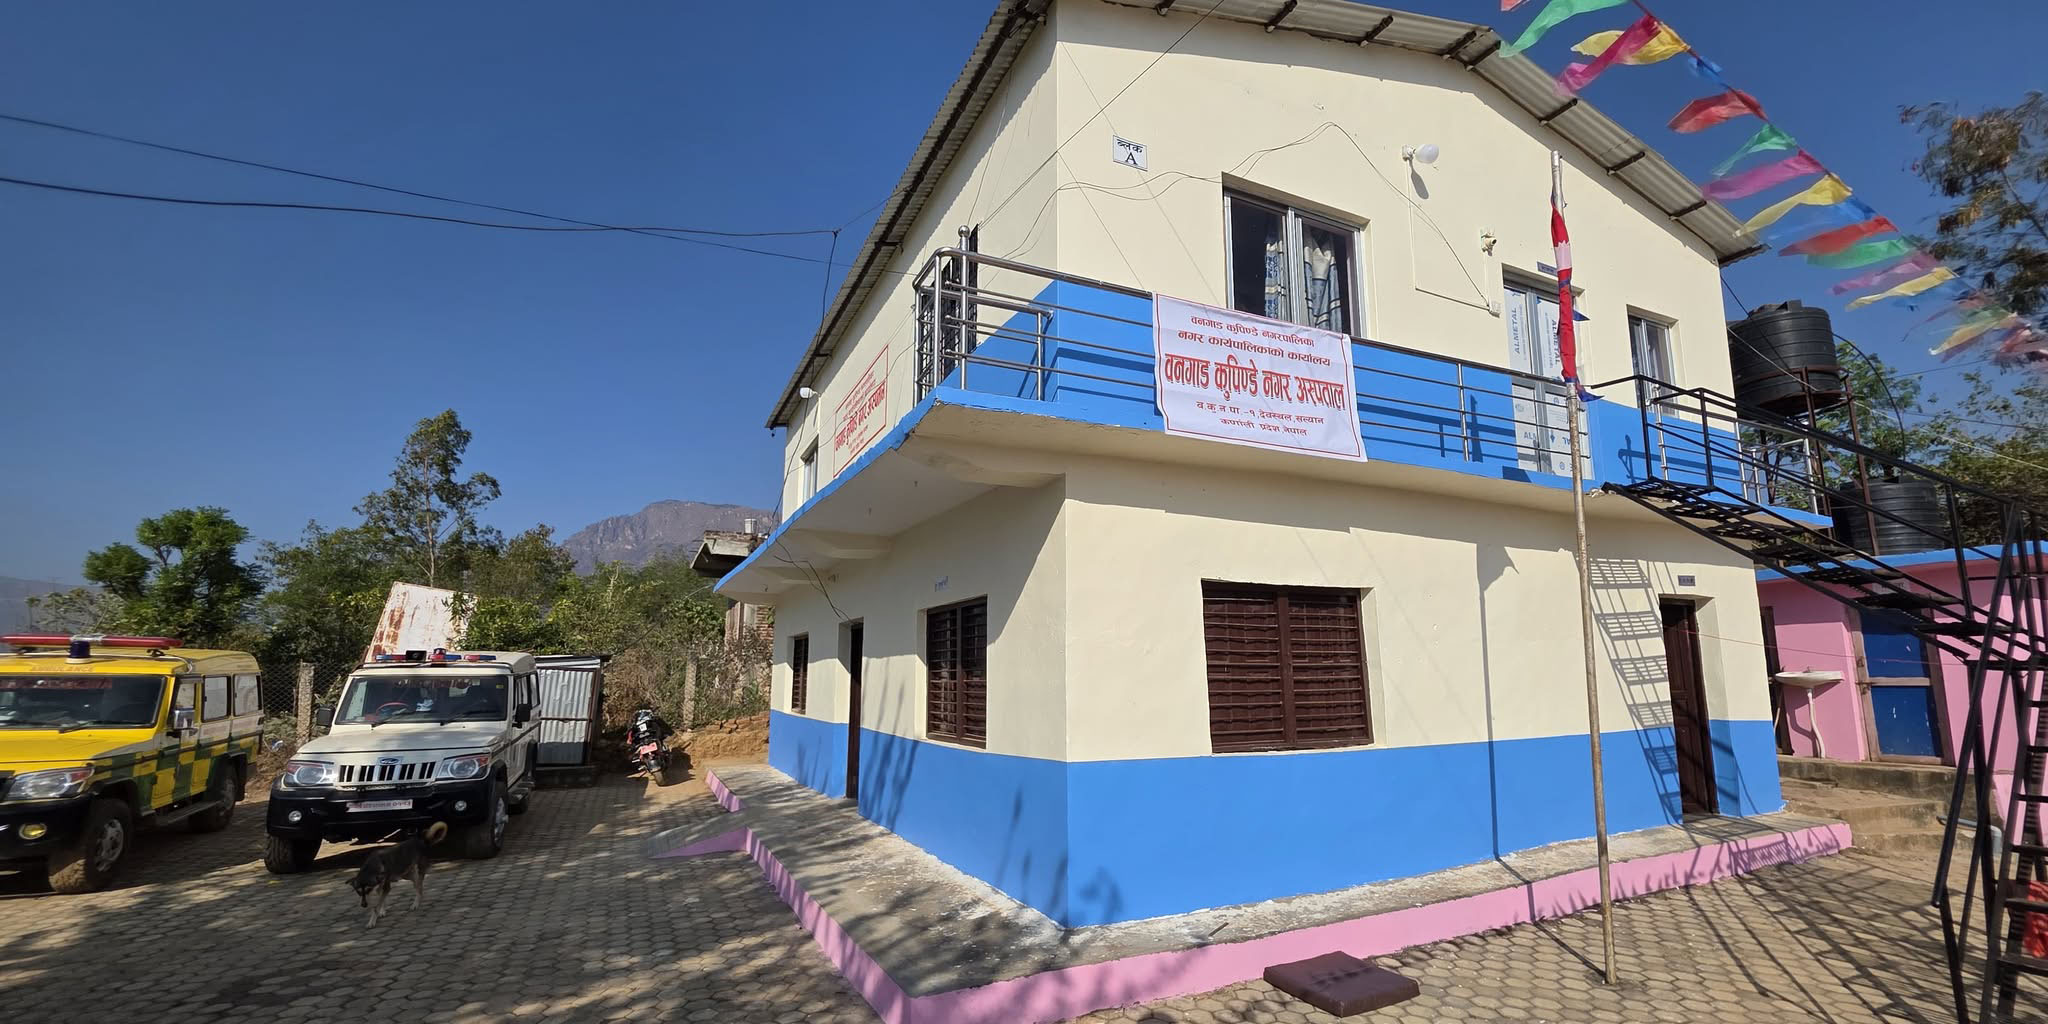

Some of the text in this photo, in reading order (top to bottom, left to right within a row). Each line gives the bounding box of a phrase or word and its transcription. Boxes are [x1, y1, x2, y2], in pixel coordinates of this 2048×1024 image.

[1125, 152, 1138, 166] A
[1178, 329, 1204, 344] नगर
[1288, 347, 1331, 366] कार्यालय
[1511, 307, 1520, 355] ALMETAL
[1261, 369, 1294, 404] नगर
[1294, 376, 1347, 411] अस्पताल
